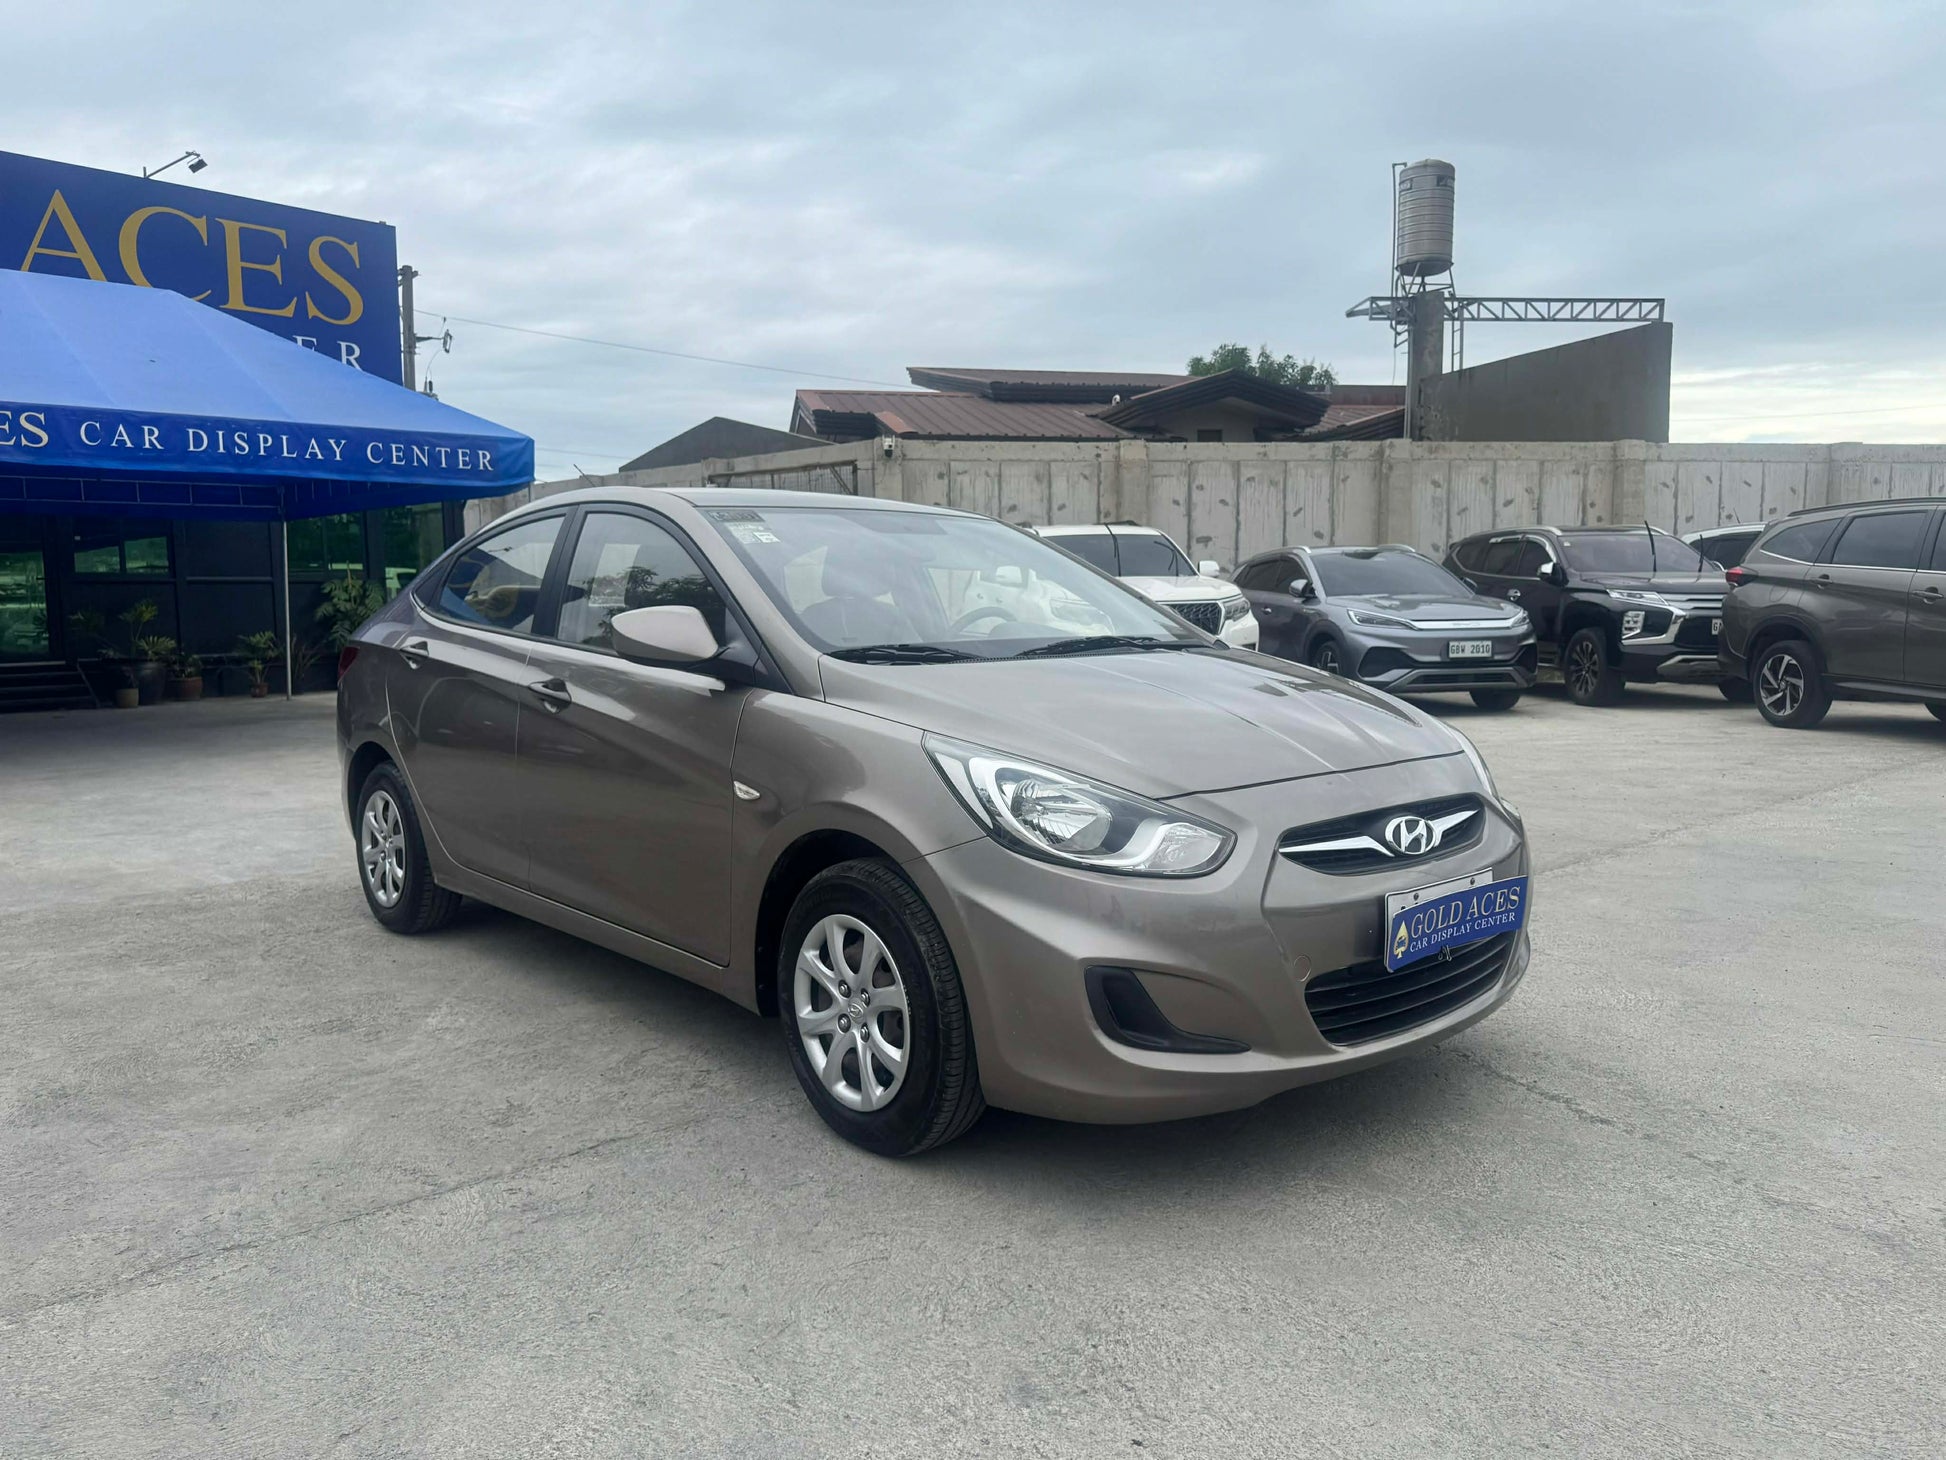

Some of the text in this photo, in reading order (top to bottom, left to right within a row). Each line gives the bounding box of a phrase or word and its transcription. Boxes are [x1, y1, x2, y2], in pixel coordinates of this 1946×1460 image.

[21, 189, 364, 325] ACES
[80, 421, 165, 449] CAR
[187, 428, 348, 461] DISPLAY
[366, 441, 494, 471] CENTER
[1410, 912, 1515, 952] CAR DISPLAY CENTER
[1411, 886, 1521, 938] GOLD ACES
